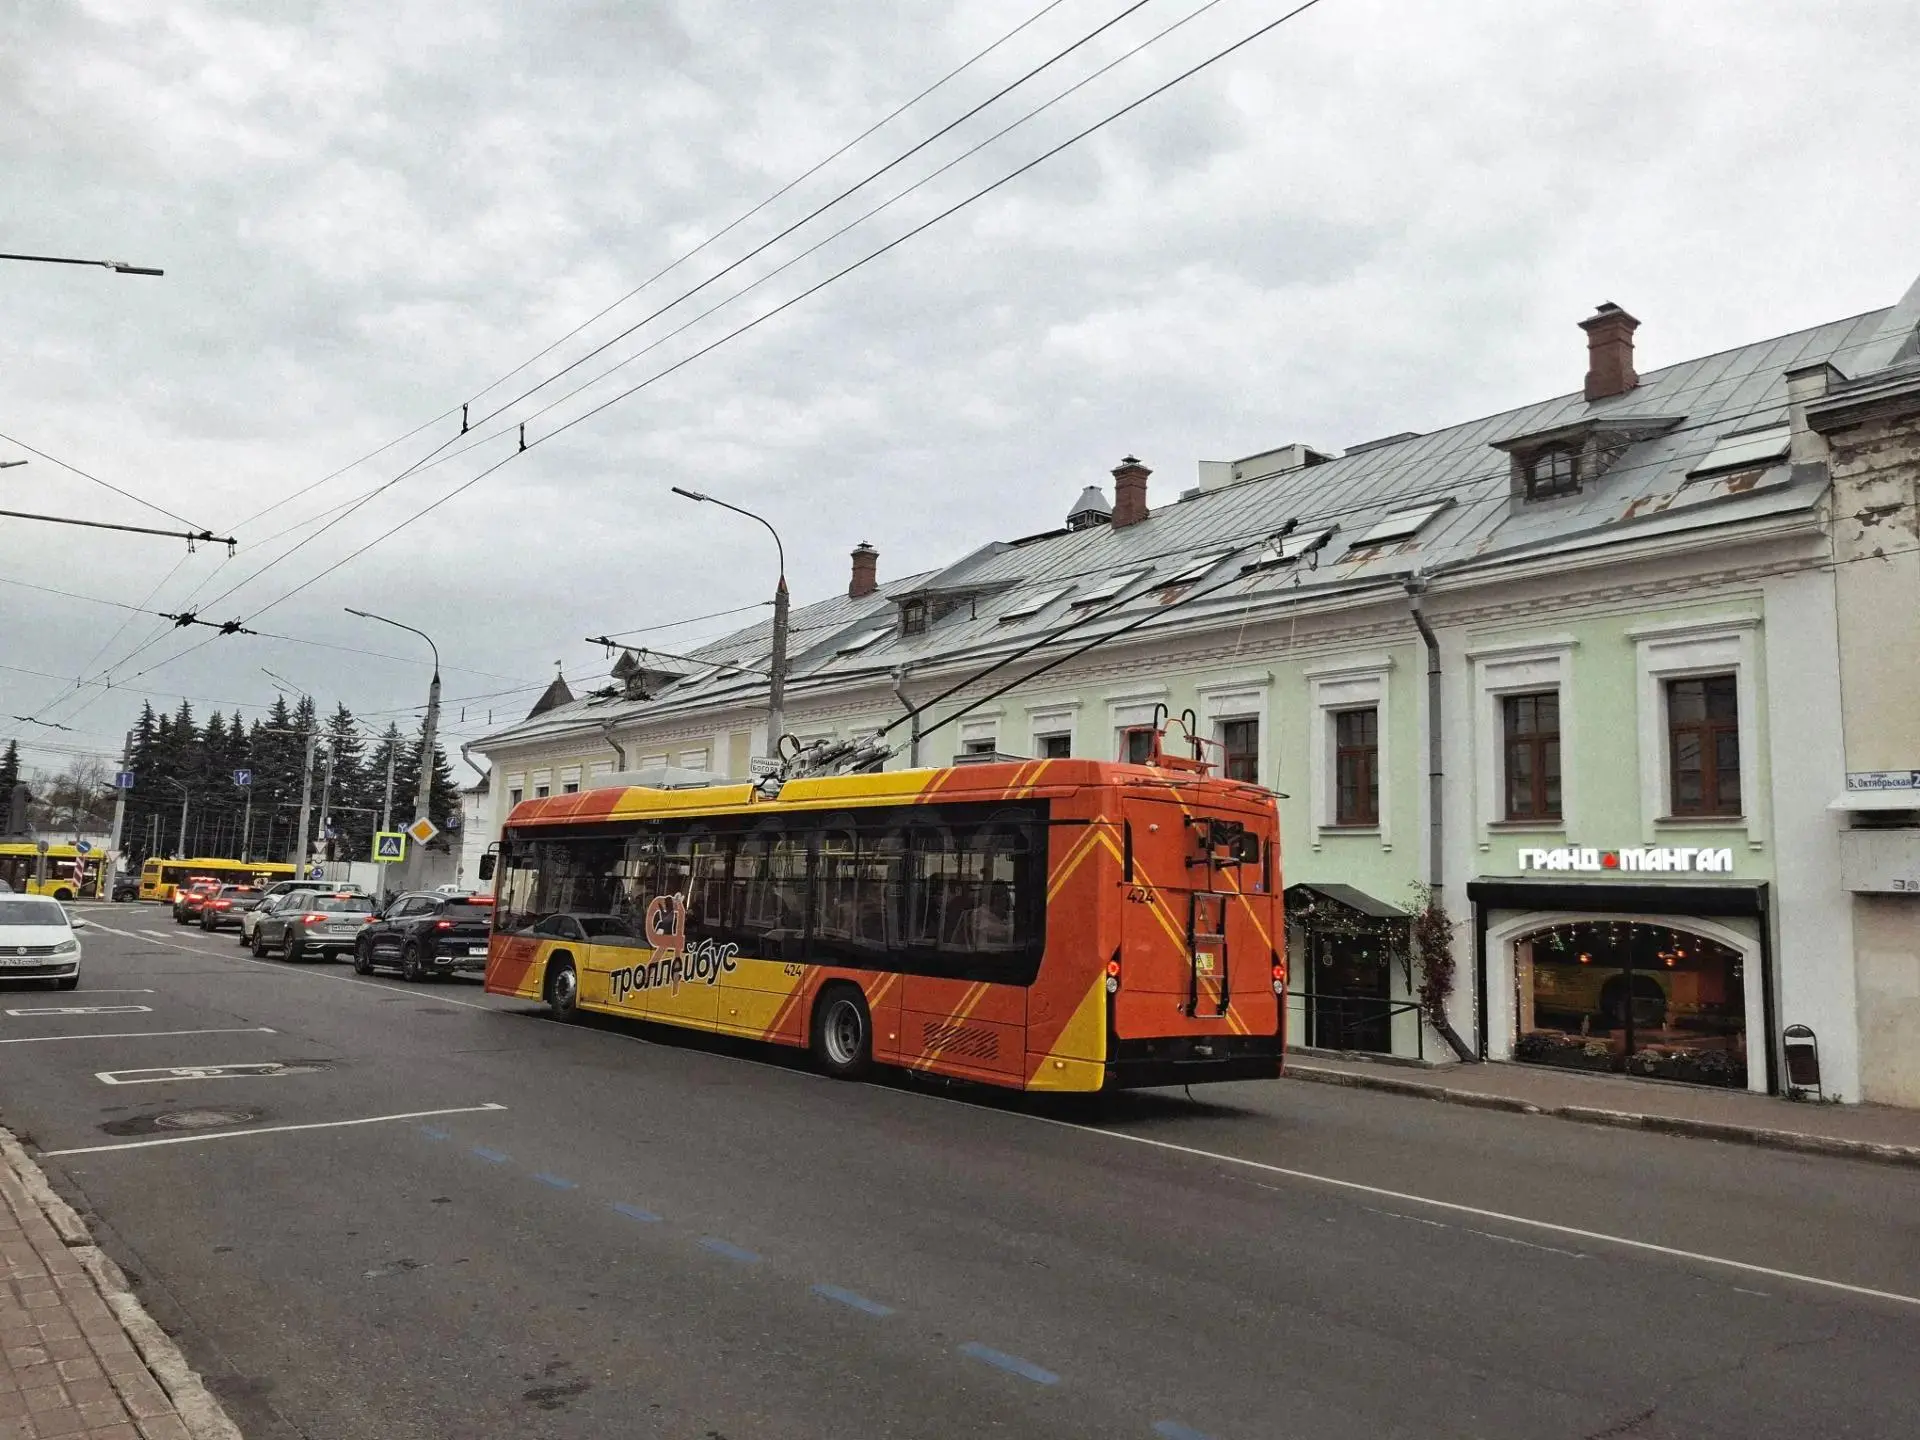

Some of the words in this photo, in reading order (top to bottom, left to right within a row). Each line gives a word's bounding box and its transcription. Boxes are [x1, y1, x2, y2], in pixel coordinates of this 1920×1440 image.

[1858, 777, 1911, 789] Октябрьская
[1518, 848, 1600, 871] ГРАНД
[1619, 847, 1733, 872] МАНГАЛ
[1127, 887, 1155, 904] 424
[610, 938, 738, 1003] троллейбус
[783, 963, 802, 977] 424
